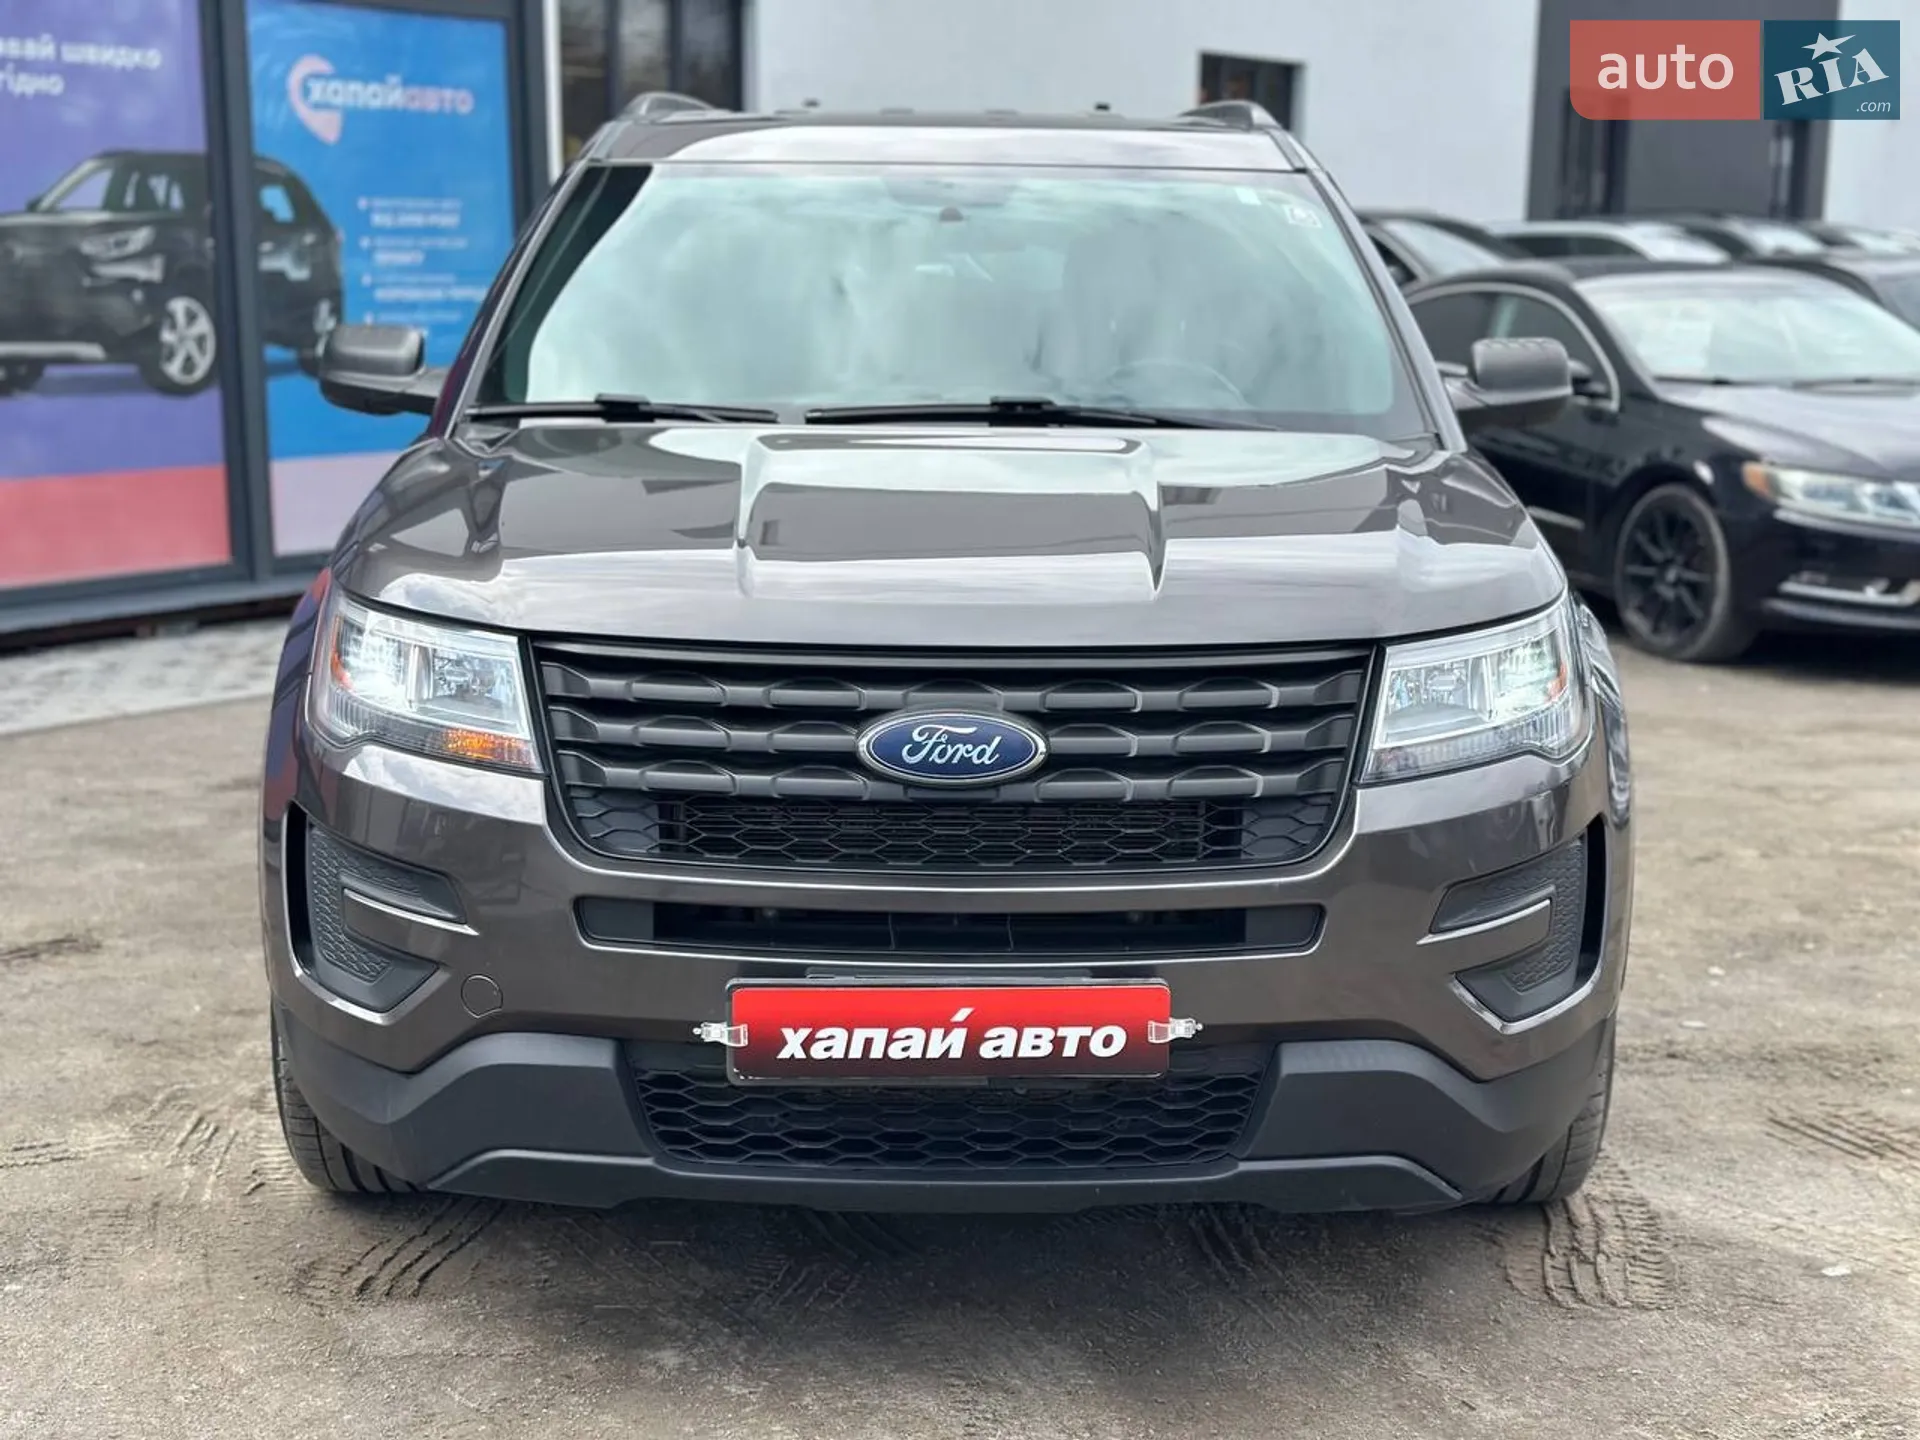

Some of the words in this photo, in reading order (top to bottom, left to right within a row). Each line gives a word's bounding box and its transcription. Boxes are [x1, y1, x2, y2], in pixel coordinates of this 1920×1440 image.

[61, 41, 162, 71] швидко
[901, 724, 1003, 765] Ford
[777, 1007, 974, 1061] хапай
[978, 1025, 1128, 1060] авто
